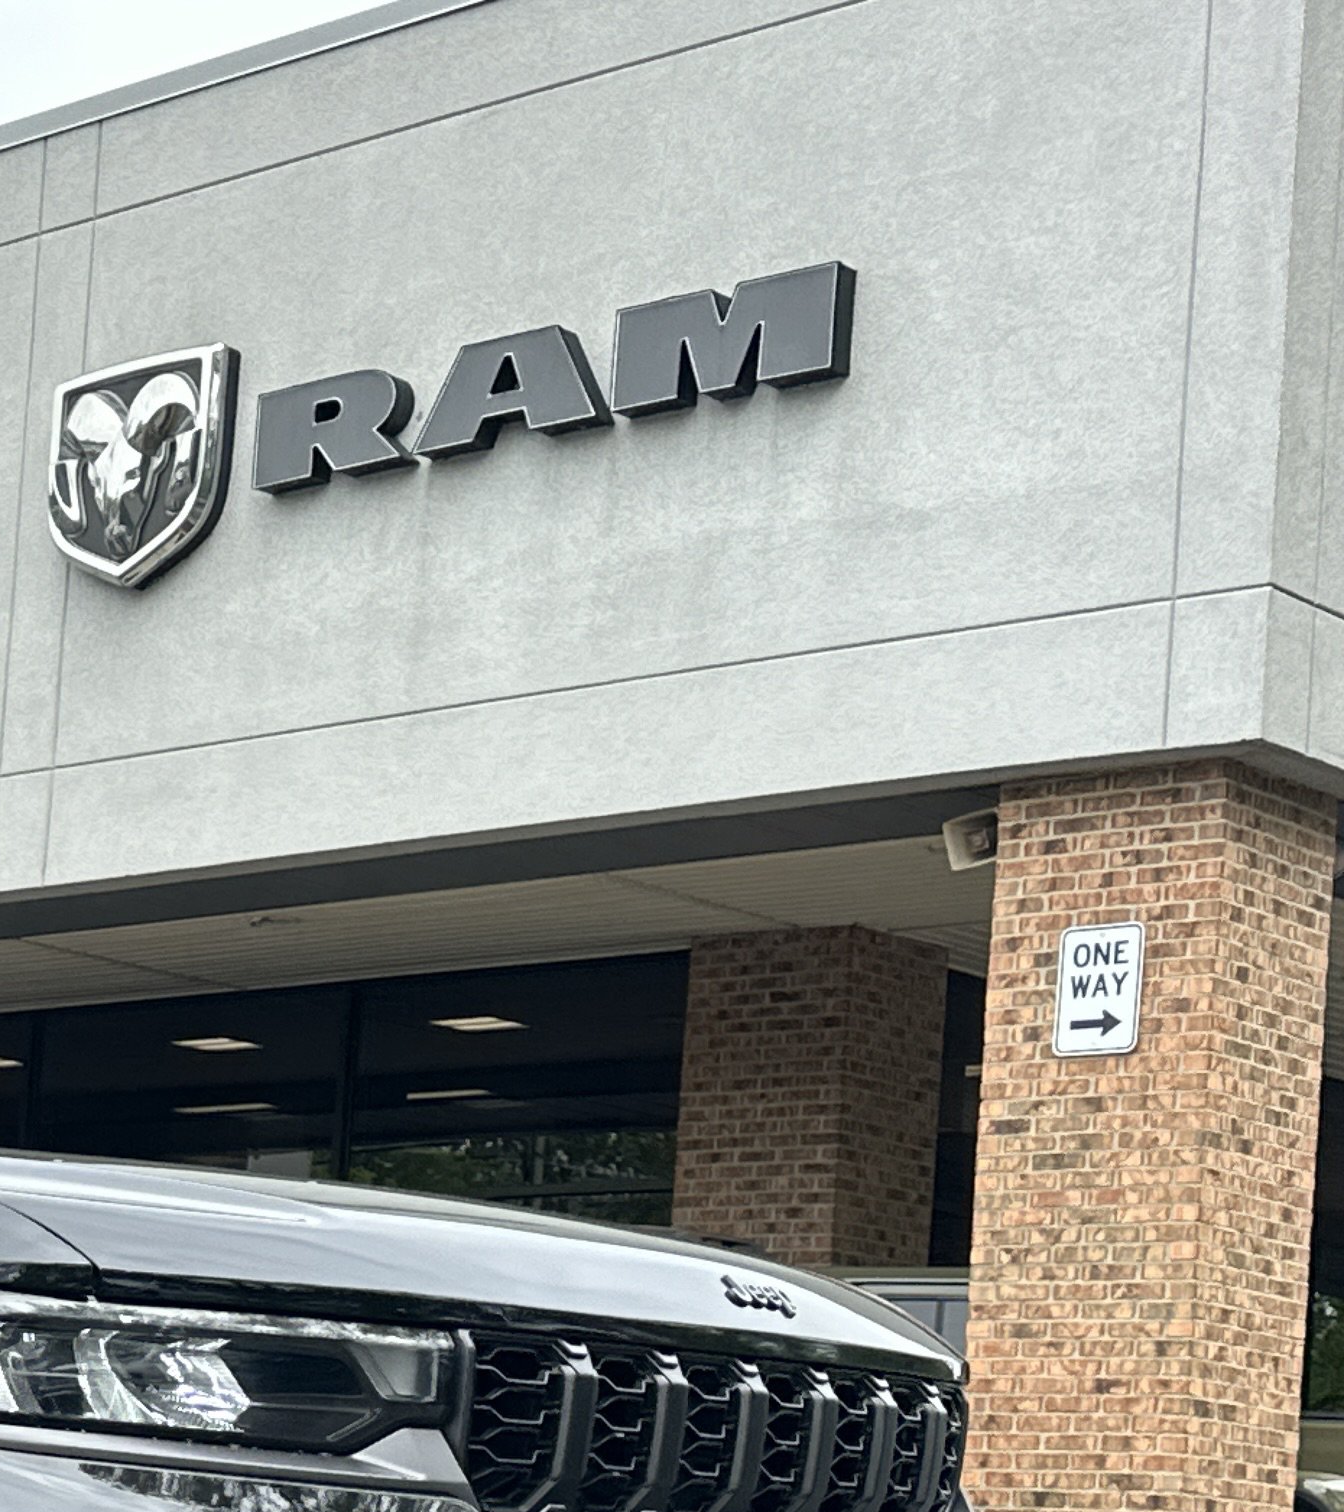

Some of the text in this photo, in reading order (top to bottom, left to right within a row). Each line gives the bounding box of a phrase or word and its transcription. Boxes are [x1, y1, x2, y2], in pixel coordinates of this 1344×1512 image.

[252, 261, 857, 494] RAM
[1074, 940, 1129, 968] ONE
[1072, 971, 1128, 999] WAY
[720, 1275, 796, 1319] Jeep
